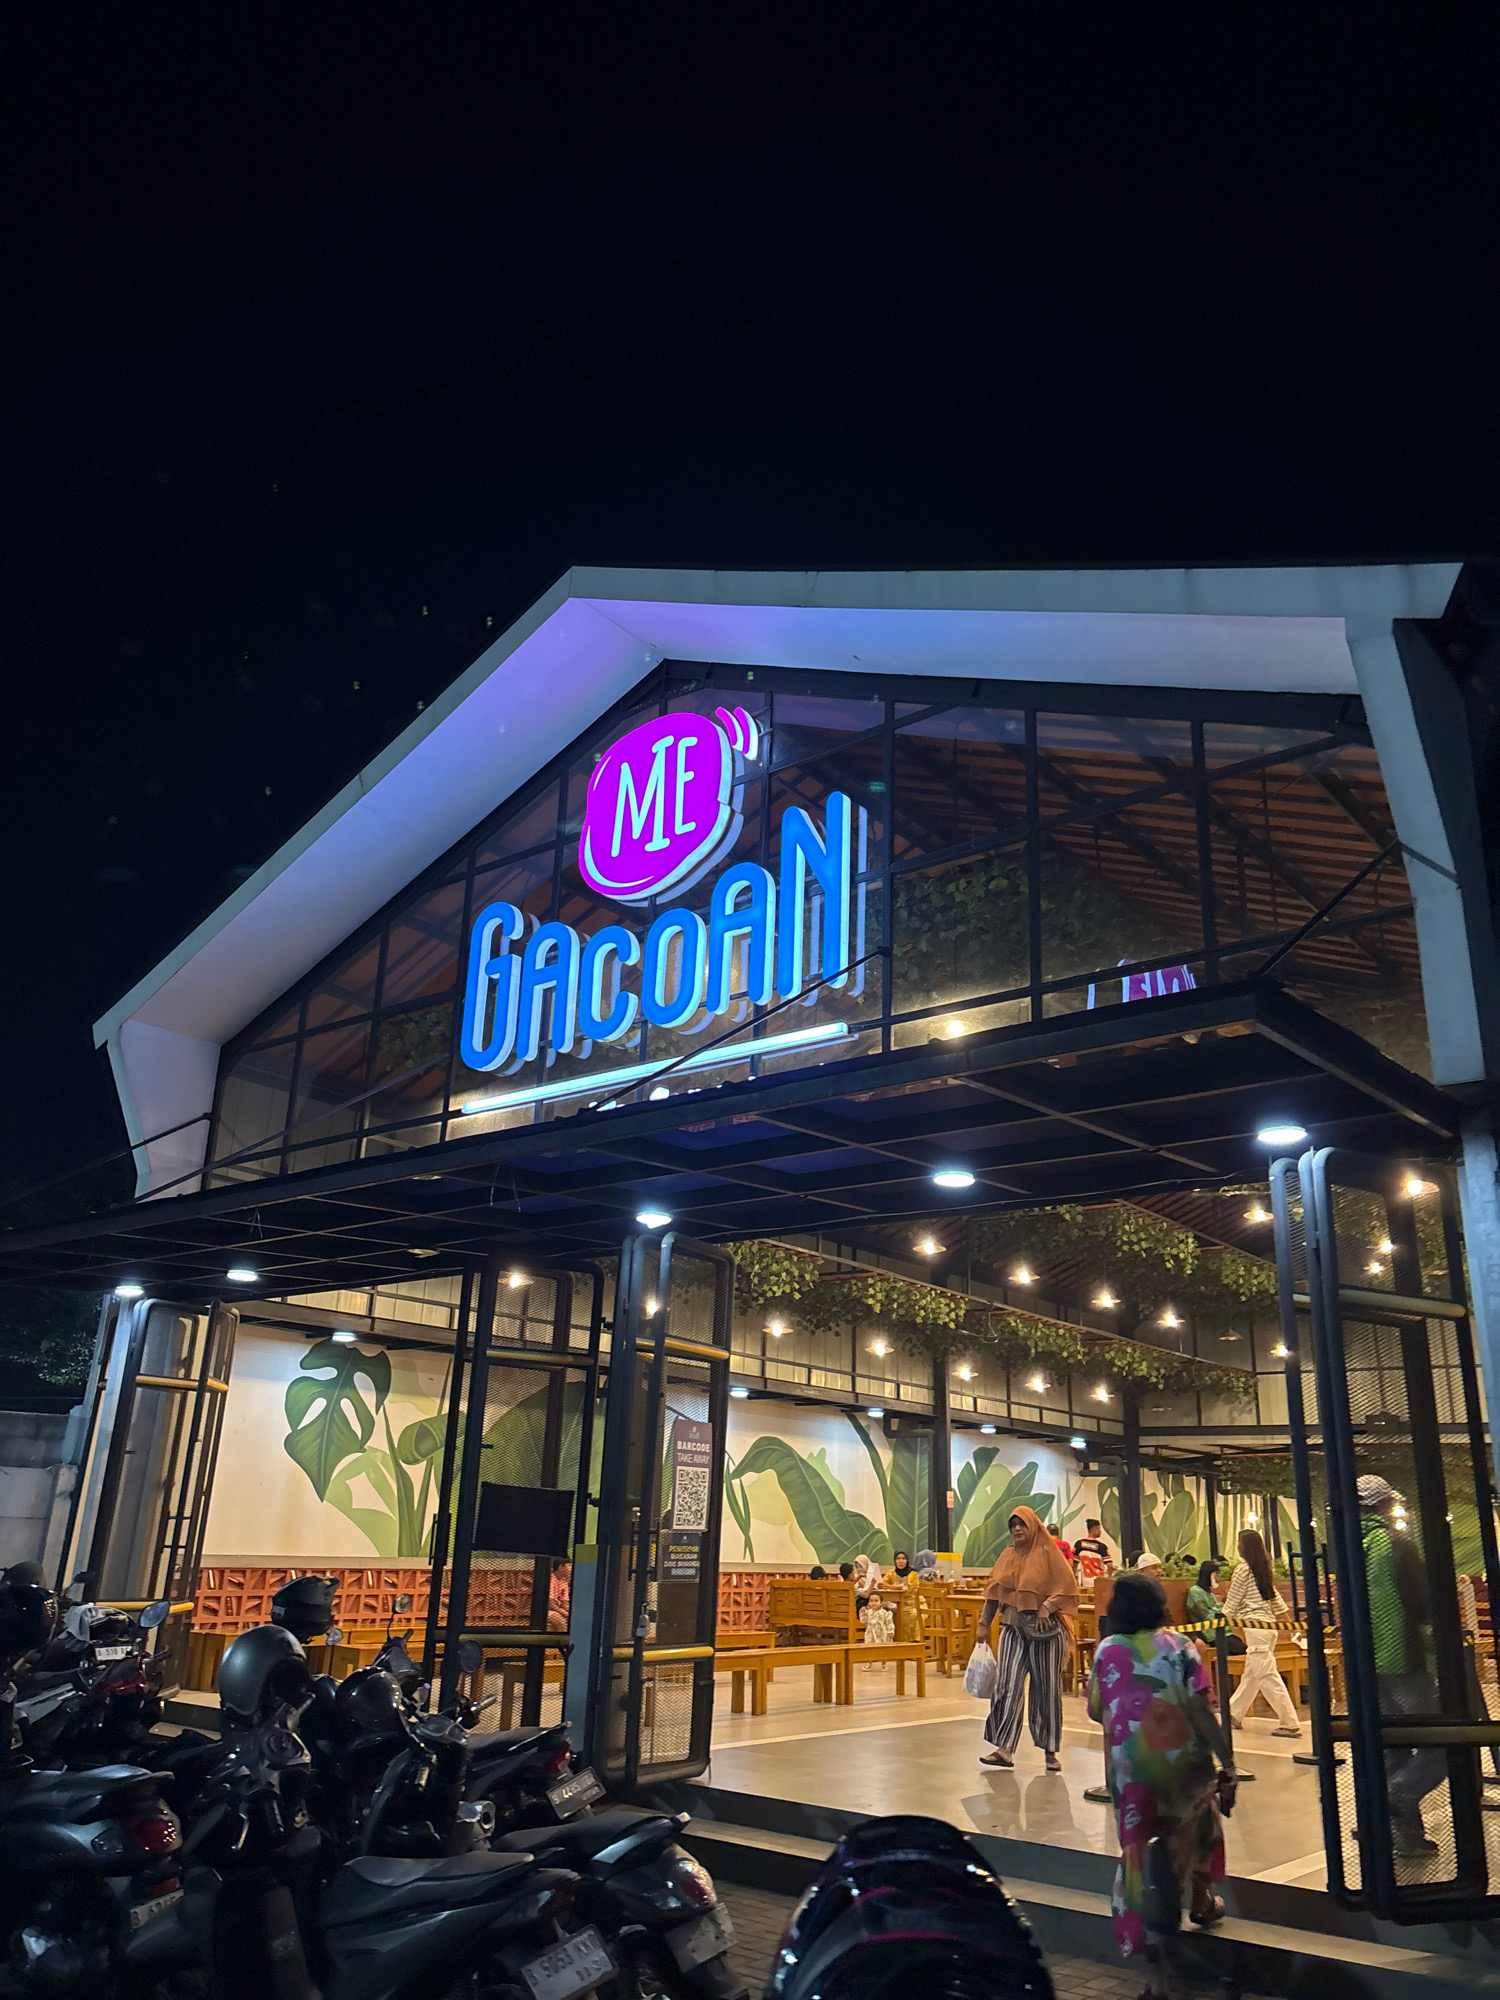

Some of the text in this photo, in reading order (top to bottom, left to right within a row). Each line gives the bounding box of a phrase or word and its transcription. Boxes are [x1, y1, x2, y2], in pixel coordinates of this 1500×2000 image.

[460, 791, 853, 1072] GACOAN
[676, 1440, 711, 1453] BARCODE
[677, 1452, 710, 1465] TAKE AWAY
